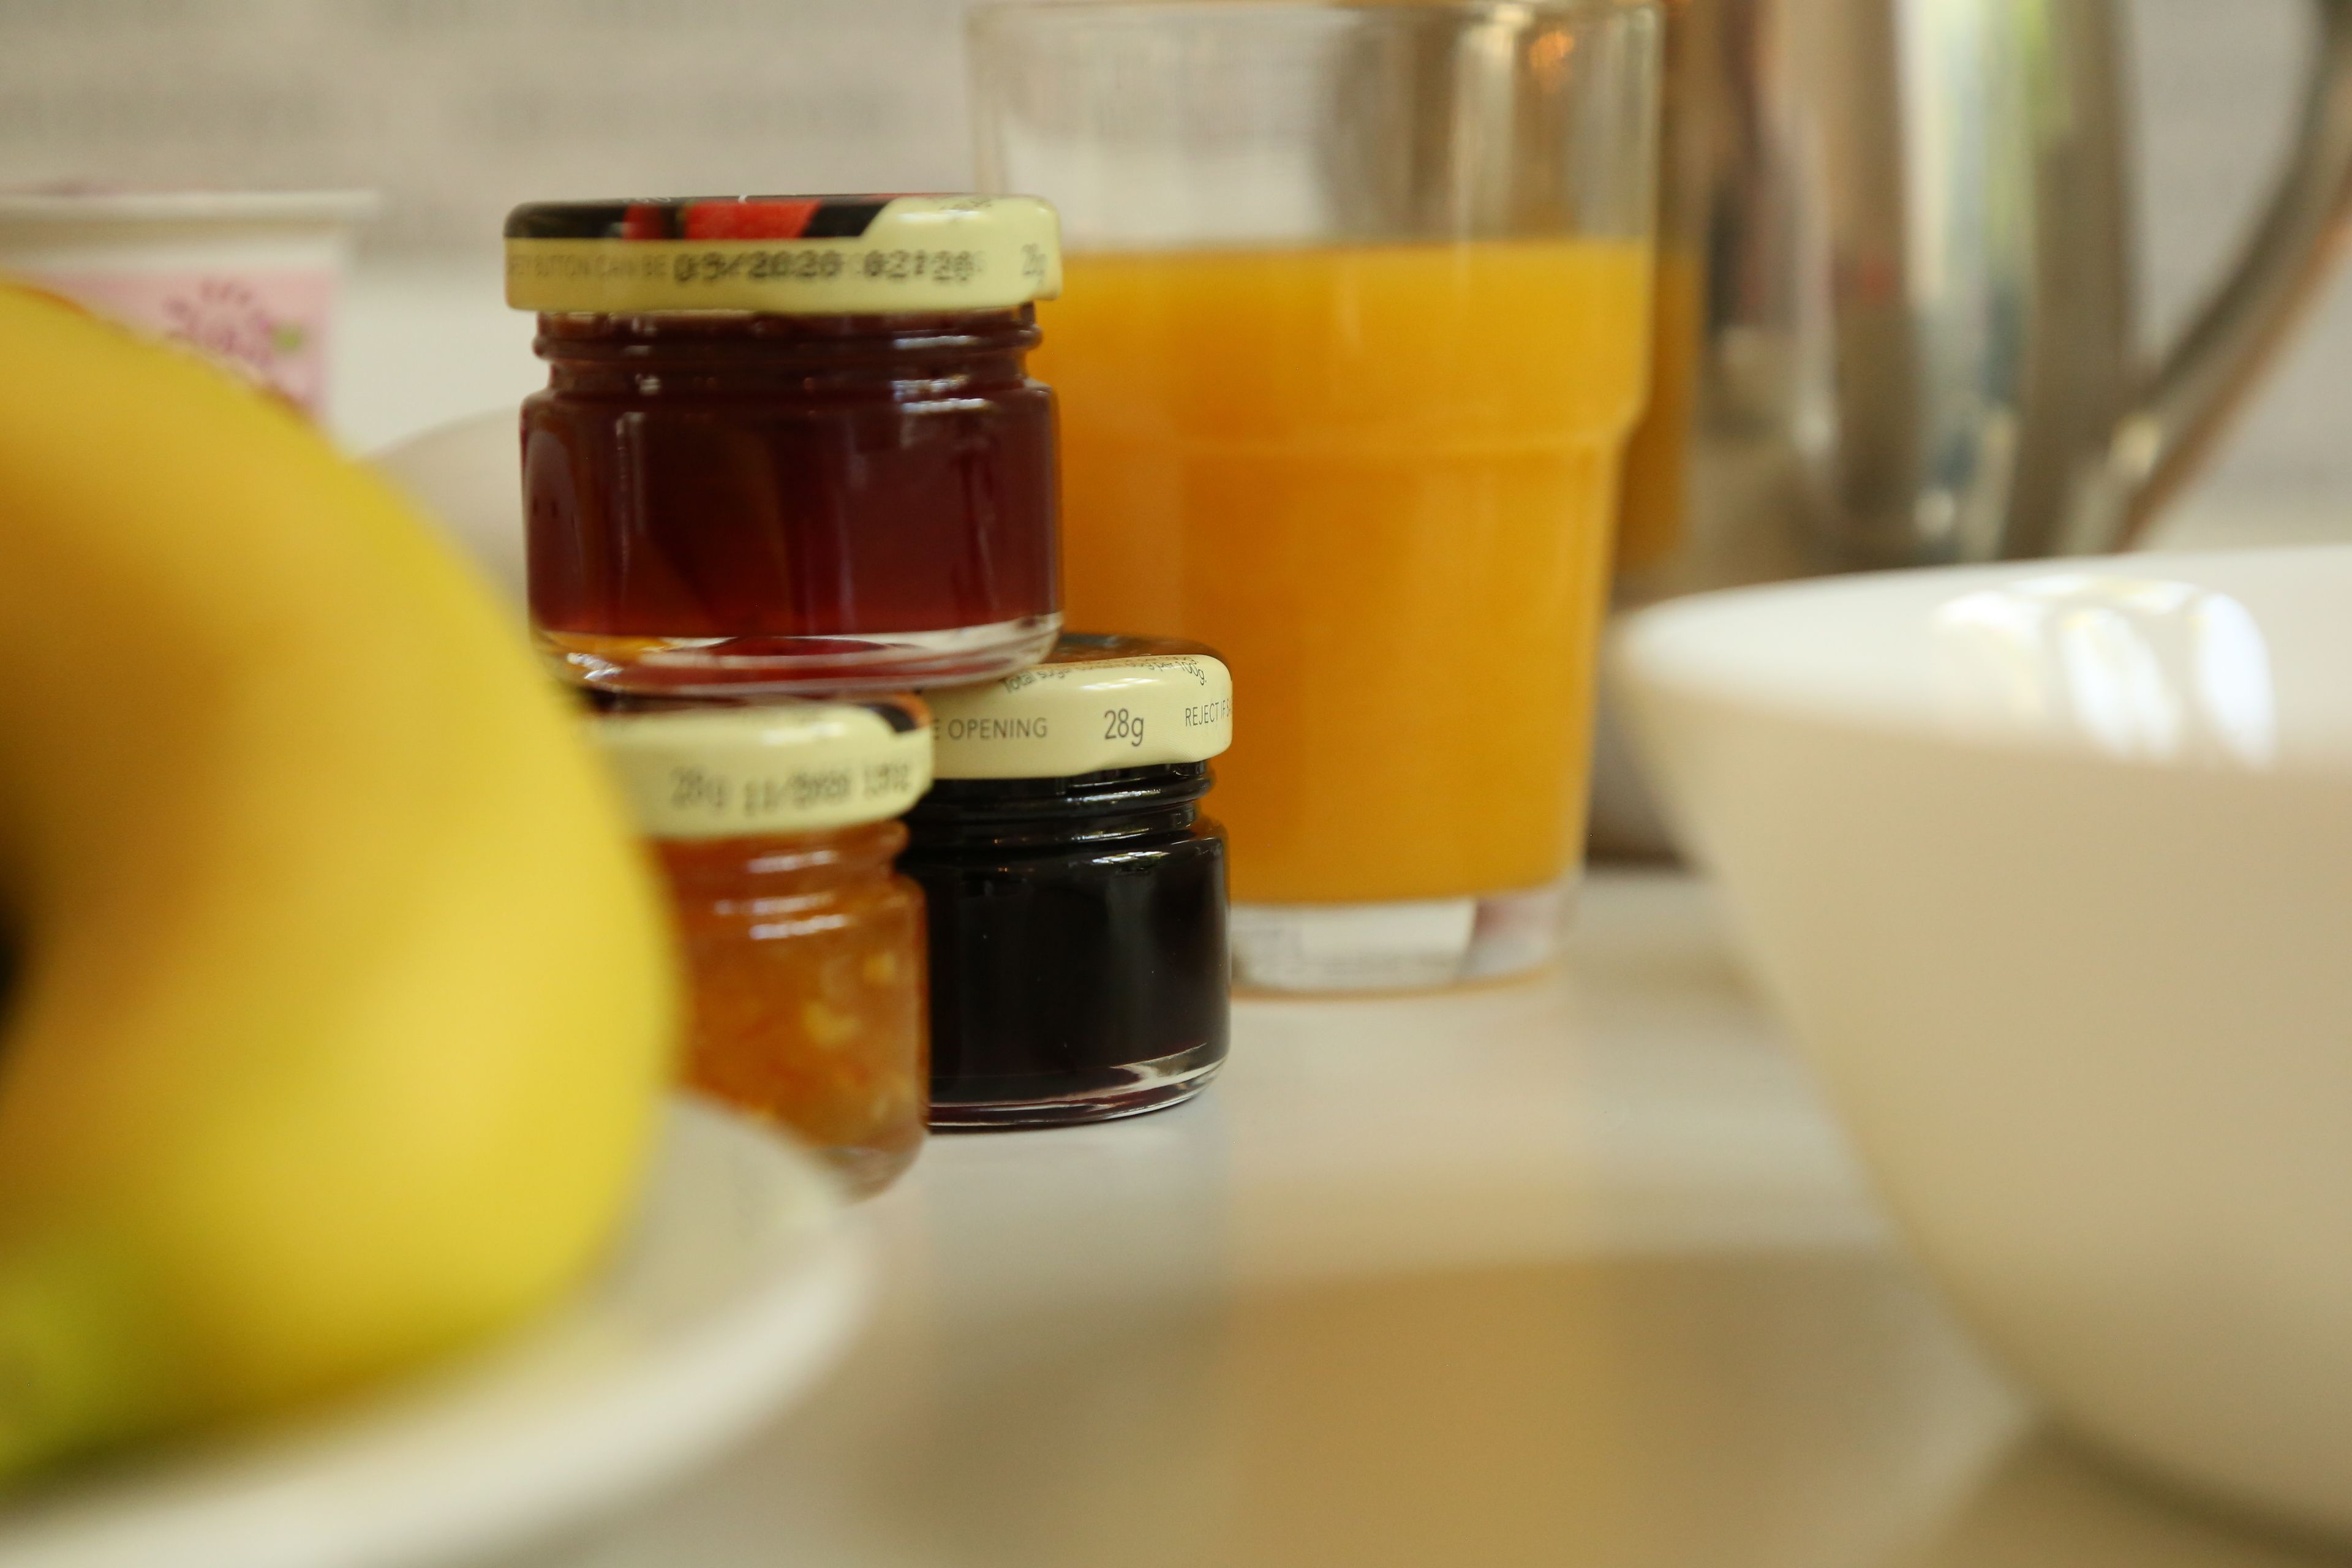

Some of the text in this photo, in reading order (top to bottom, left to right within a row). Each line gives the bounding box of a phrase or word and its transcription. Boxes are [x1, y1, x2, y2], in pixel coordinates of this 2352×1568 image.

[641, 252, 668, 277] BE
[1185, 701, 1219, 727] REJECT
[948, 717, 1049, 741] OPENING
[1104, 709, 1145, 746] 28g
